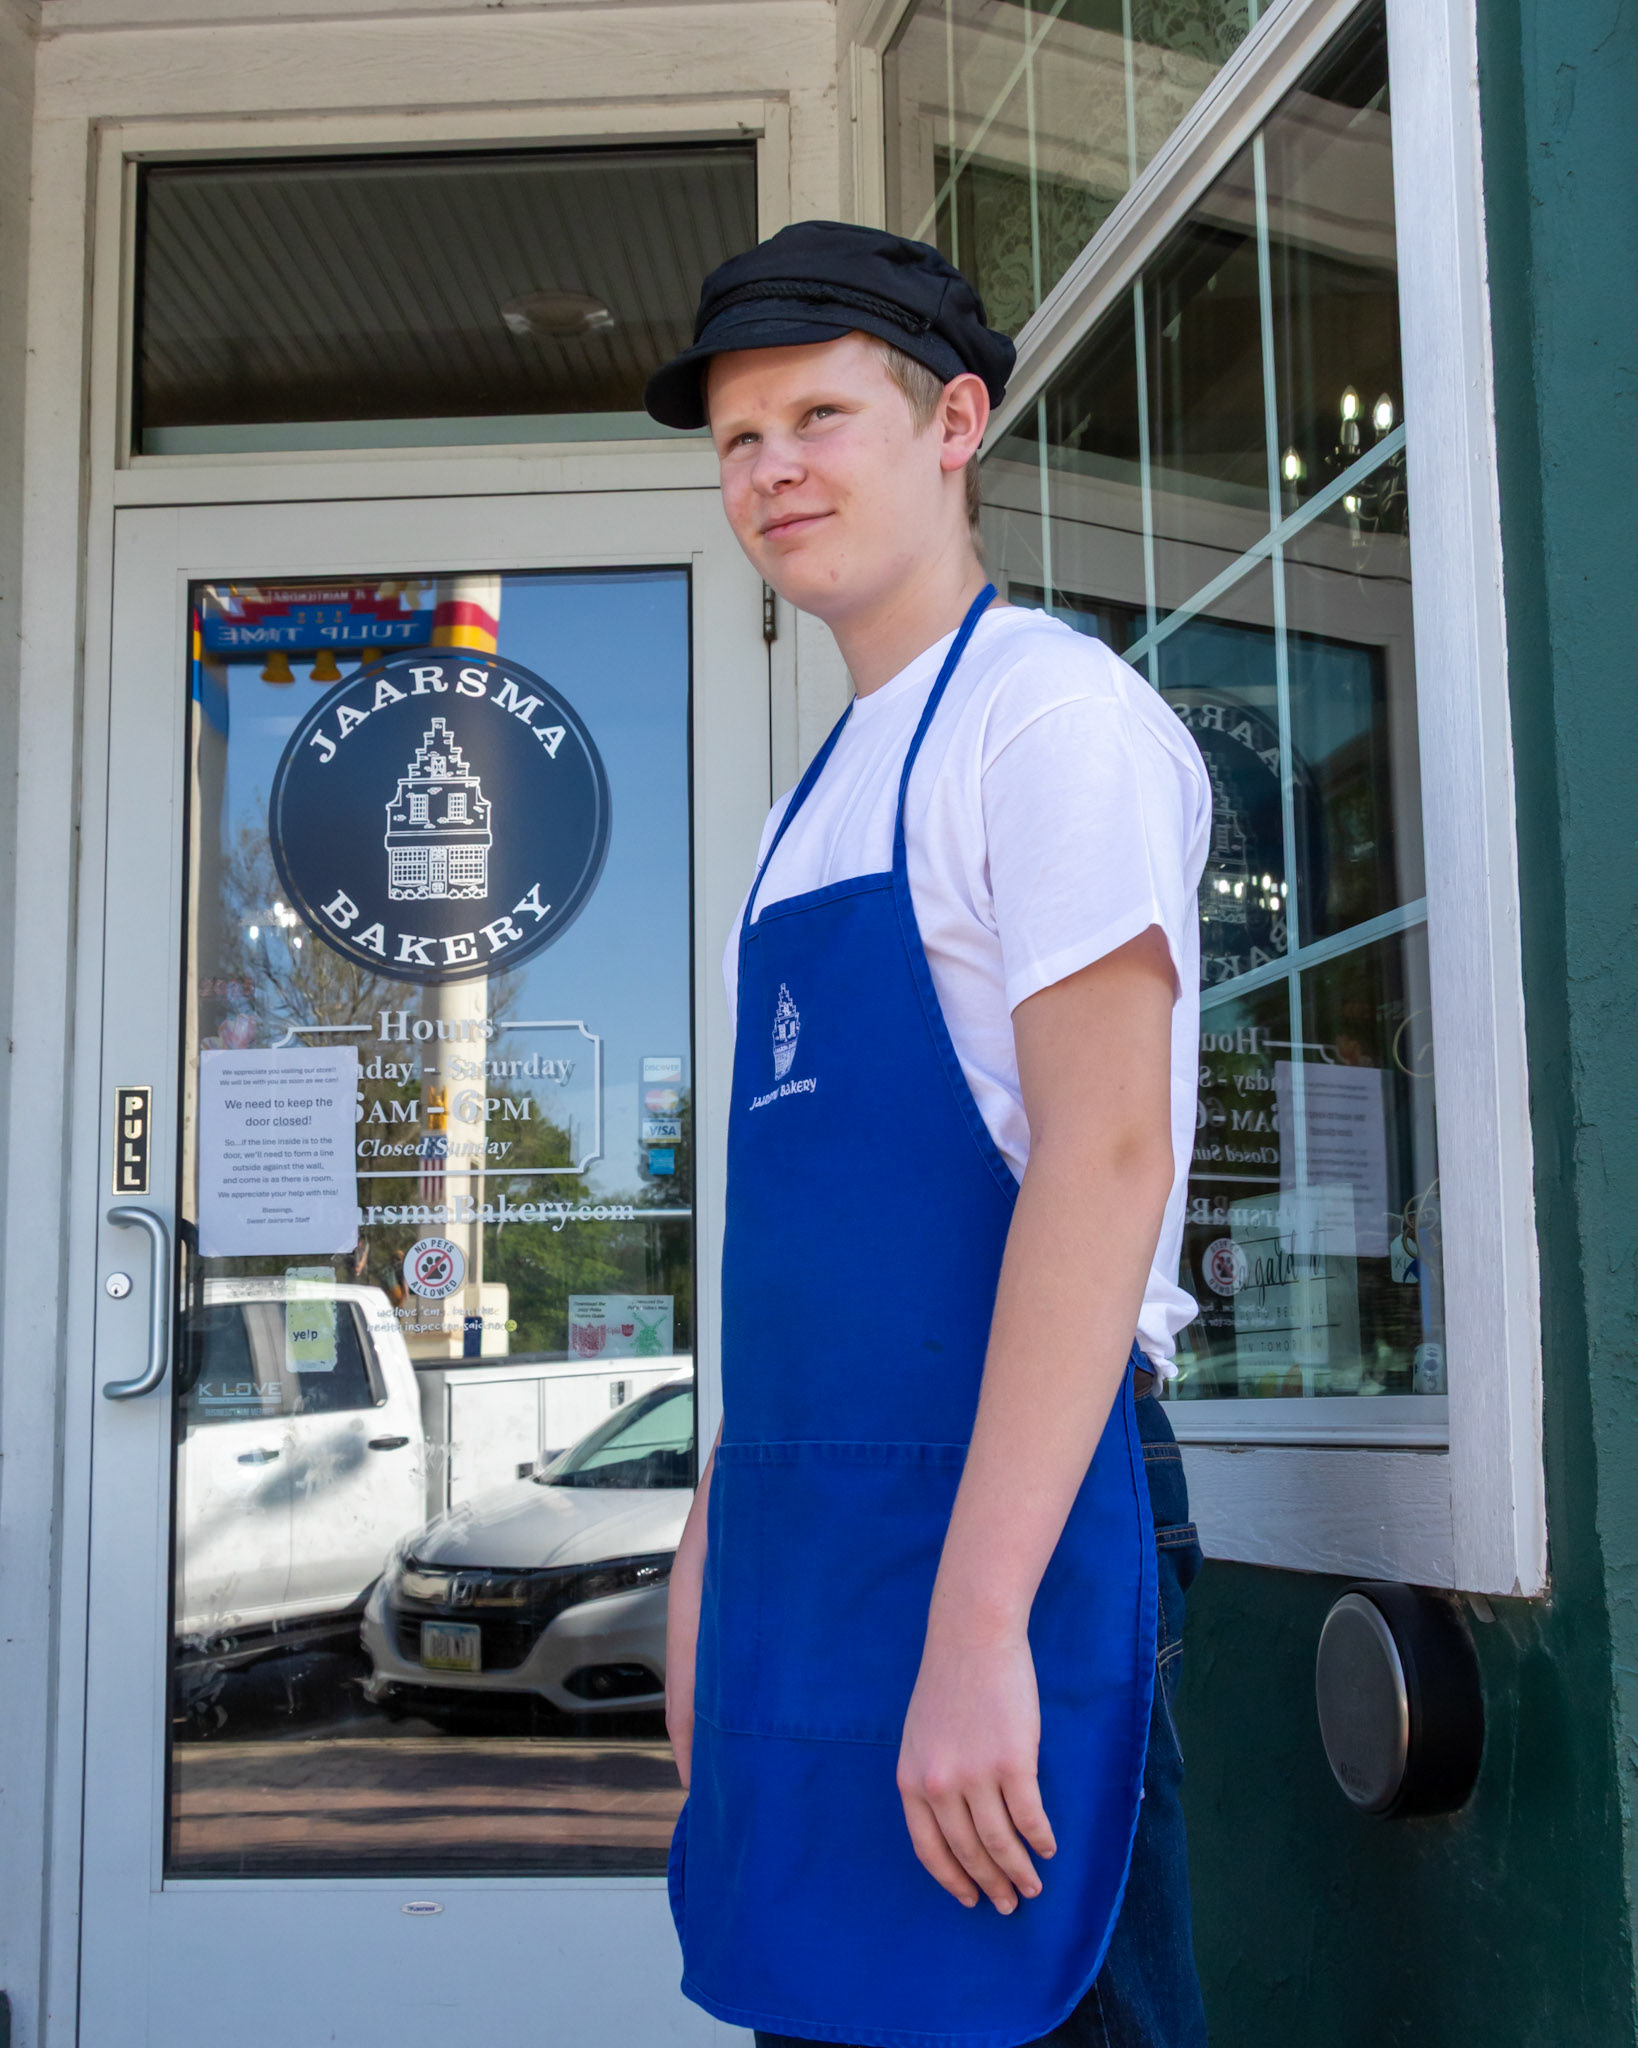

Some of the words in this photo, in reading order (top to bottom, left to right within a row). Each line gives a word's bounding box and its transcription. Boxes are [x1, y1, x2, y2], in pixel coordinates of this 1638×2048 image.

[309, 664, 568, 765] JAARSMA
[320, 882, 553, 968] BAKERY
[377, 1010, 495, 1041] Hours
[445, 1053, 572, 1084] Saturday
[225, 1099, 242, 1109] We
[245, 1099, 271, 1109] need
[274, 1099, 285, 1108] to
[287, 1098, 314, 1110] keep
[315, 1097, 333, 1107] the
[452, 1089, 531, 1124] 6PM
[245, 1116, 270, 1127] door
[272, 1115, 312, 1126] closed!
[649, 1125, 676, 1136] VISA
[123, 1096, 144, 1186] PULL
[248, 1139, 261, 1147] the
[262, 1138, 276, 1146] line
[277, 1138, 301, 1146] inside
[223, 1151, 243, 1160] door,
[263, 1150, 283, 1158] need
[284, 1150, 293, 1158] to
[293, 1149, 312, 1157] form
[319, 1149, 334, 1157] line
[357, 1138, 430, 1158] Closed
[434, 1137, 512, 1160] Sunday
[232, 1164, 262, 1172] outside
[262, 1163, 291, 1172] against
[291, 1162, 305, 1170] the
[222, 1176, 237, 1184] and
[281, 1175, 301, 1183] there
[231, 1191, 270, 1199] appreciate
[270, 1191, 288, 1200] your
[288, 1189, 305, 1199] help
[305, 1189, 322, 1197] with
[414, 1241, 427, 1254] NO
[431, 1239, 455, 1253] PETS
[411, 1279, 457, 1297] ALLOWED
[394, 1306, 418, 1318] love
[404, 1321, 461, 1333] inspector
[292, 1328, 318, 1342] yelp
[222, 1382, 283, 1397] LOVE
